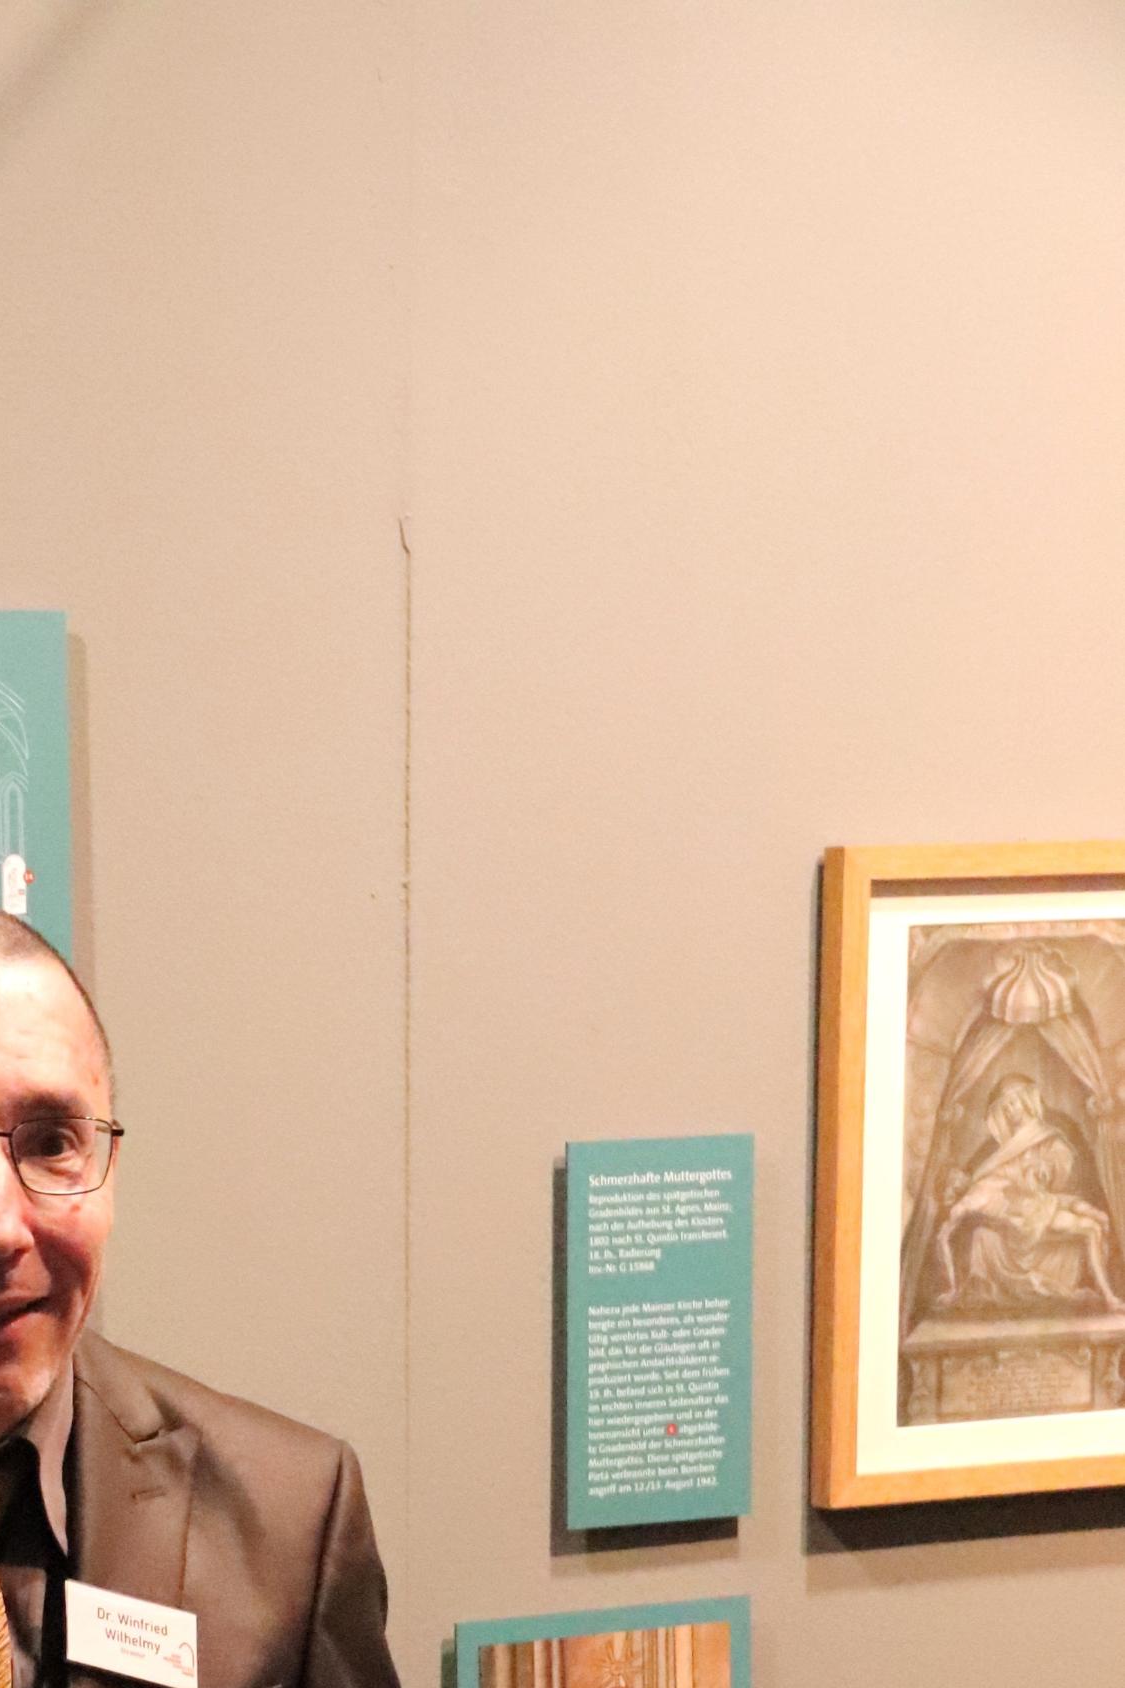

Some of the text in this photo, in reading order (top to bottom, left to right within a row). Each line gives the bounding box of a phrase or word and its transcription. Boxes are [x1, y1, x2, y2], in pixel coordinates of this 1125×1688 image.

[589, 1169, 732, 1187] Schmerzhafte Muttergottes
[589, 1192, 644, 1205] Reproduktion
[646, 1192, 660, 1200] des
[589, 1222, 609, 1232] nach
[627, 1219, 674, 1230] Aufhebung
[675, 1218, 689, 1227] des
[691, 1216, 723, 1226] Klosters
[612, 1235, 632, 1245] nach
[619, 1248, 662, 1259] Radierung
[589, 1306, 620, 1315] Nahezu
[642, 1302, 675, 1312] Mainzer
[654, 1342, 696, 1354] Gläubigen
[698, 1340, 709, 1350] oft
[682, 1369, 700, 1378] dem
[702, 1367, 730, 1376] frühen
[617, 1387, 645, 1397] befand
[688, 1381, 719, 1393] Quintin
[665, 1478, 693, 1491] August
[118, 1613, 168, 1636] Winfried
[105, 1628, 161, 1655] Wilhelmy
